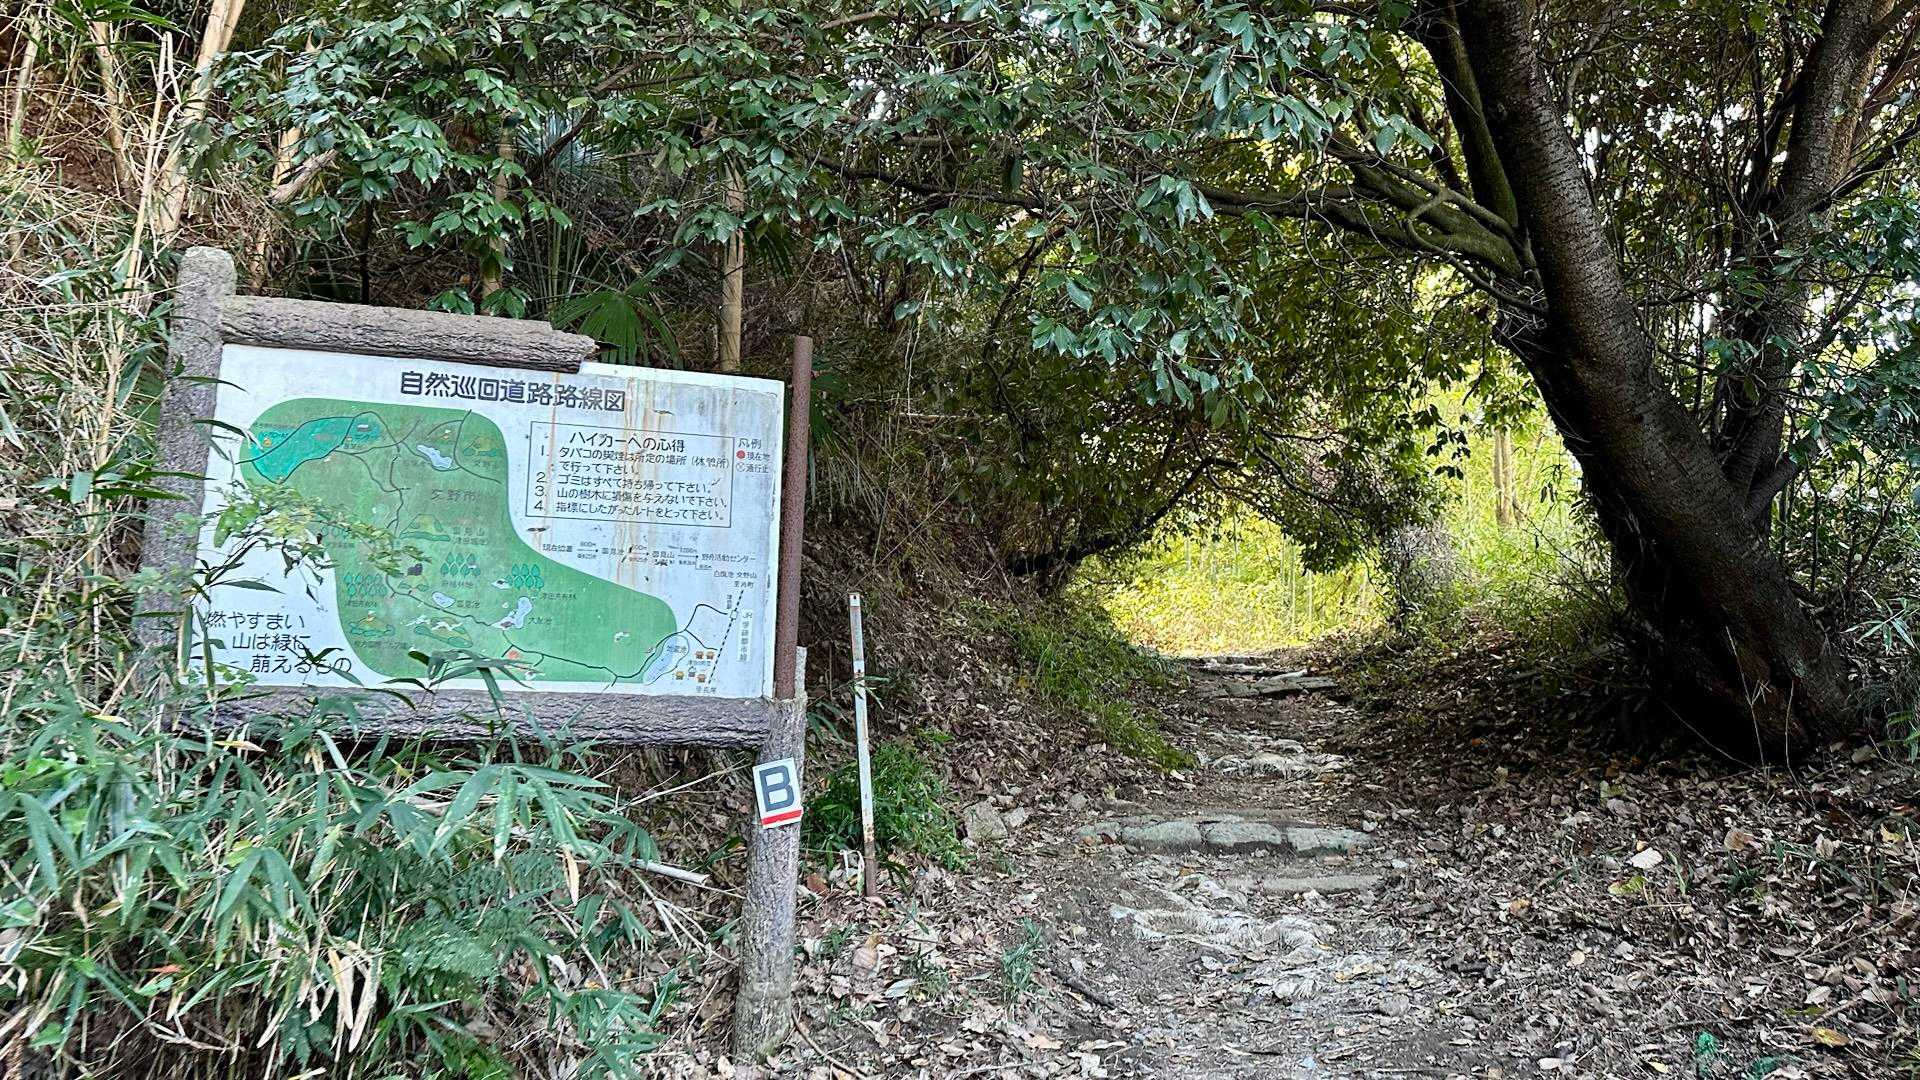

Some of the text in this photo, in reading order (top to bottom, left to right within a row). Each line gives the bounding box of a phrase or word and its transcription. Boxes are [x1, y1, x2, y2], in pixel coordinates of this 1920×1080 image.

[401, 371, 625, 412] 自然巡回道路路線図
[569, 431, 685, 453] ハイカーへの心得
[758, 764, 795, 813] B
